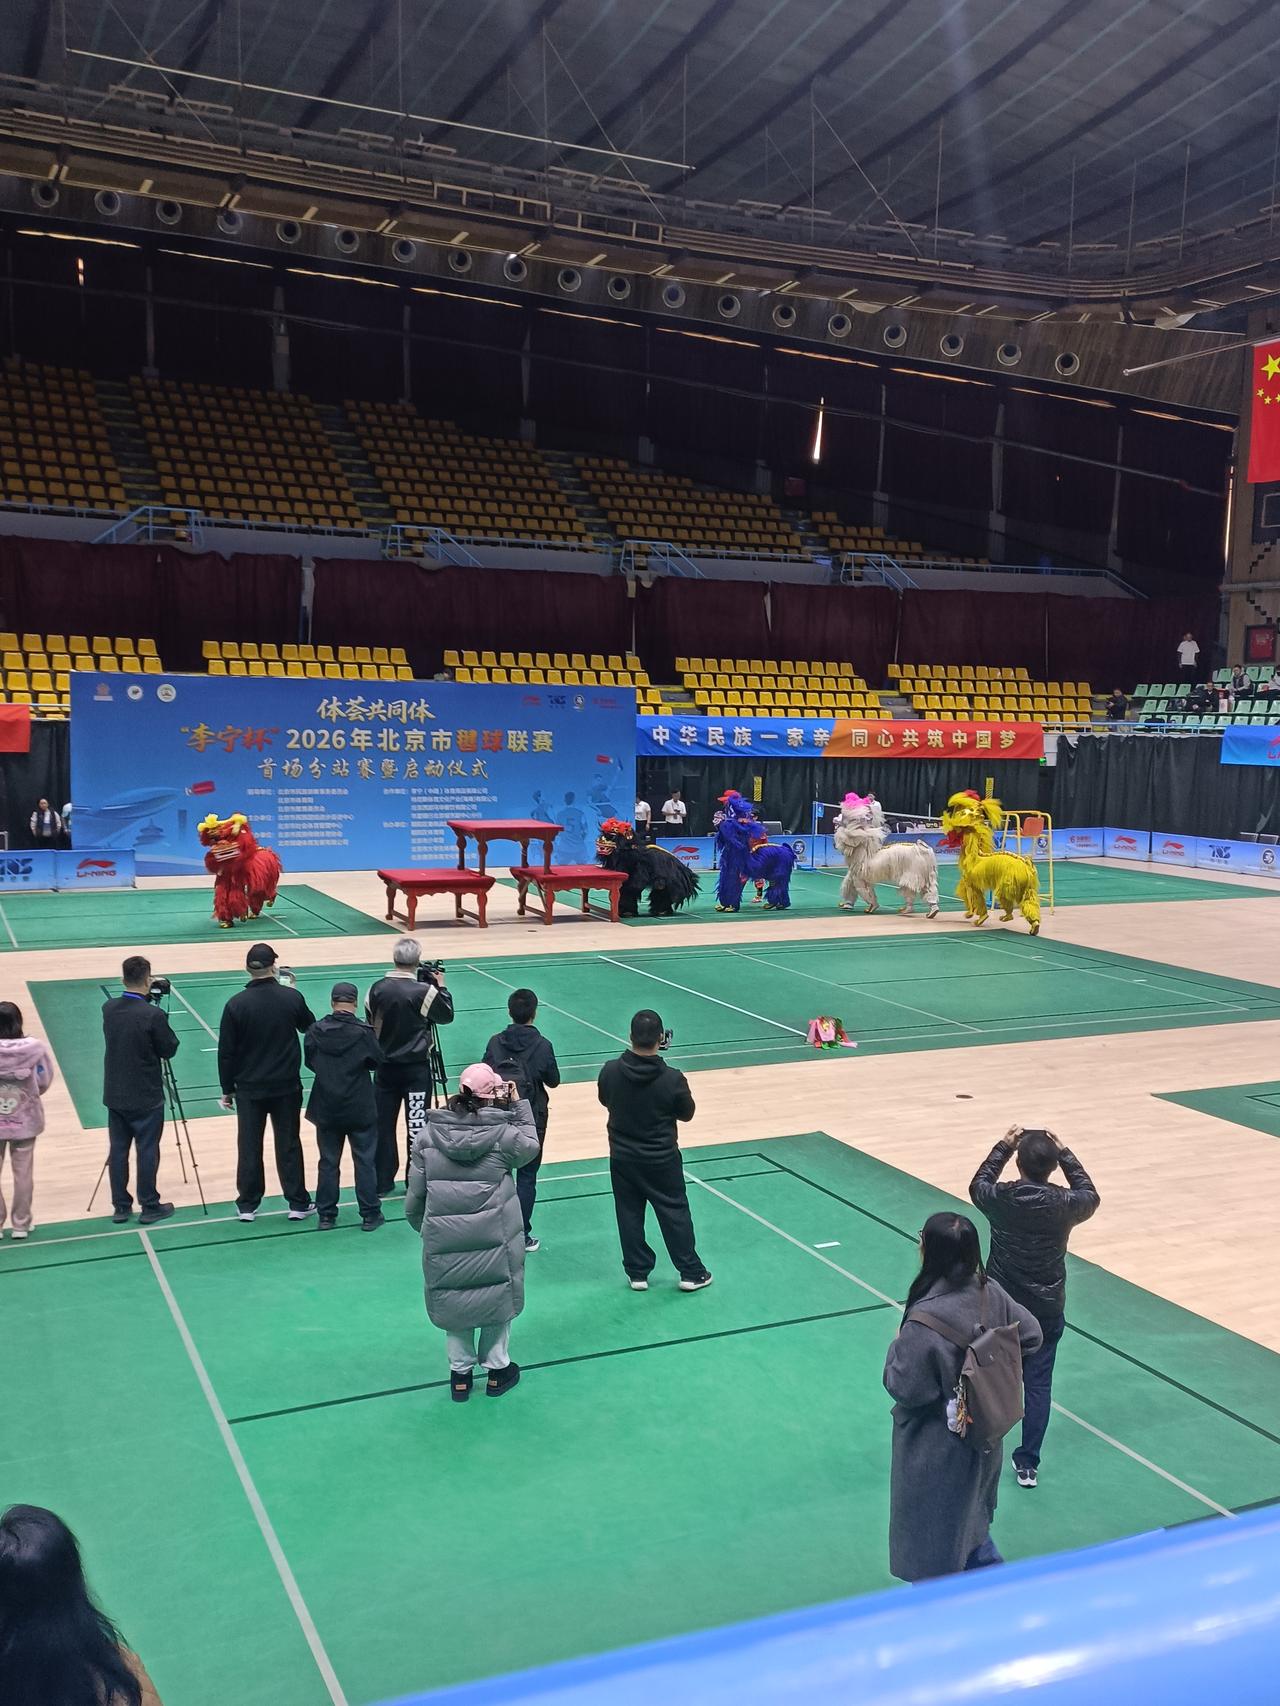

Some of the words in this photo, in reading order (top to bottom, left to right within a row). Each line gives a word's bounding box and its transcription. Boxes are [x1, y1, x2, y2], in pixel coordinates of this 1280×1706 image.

[316, 696, 436, 724] 体荟共同体
[652, 725, 829, 747] 中华民族一家亲
[851, 728, 1018, 749] 同心共筑中国梦
[258, 758, 489, 780] 首场分站赛暨启动仪式
